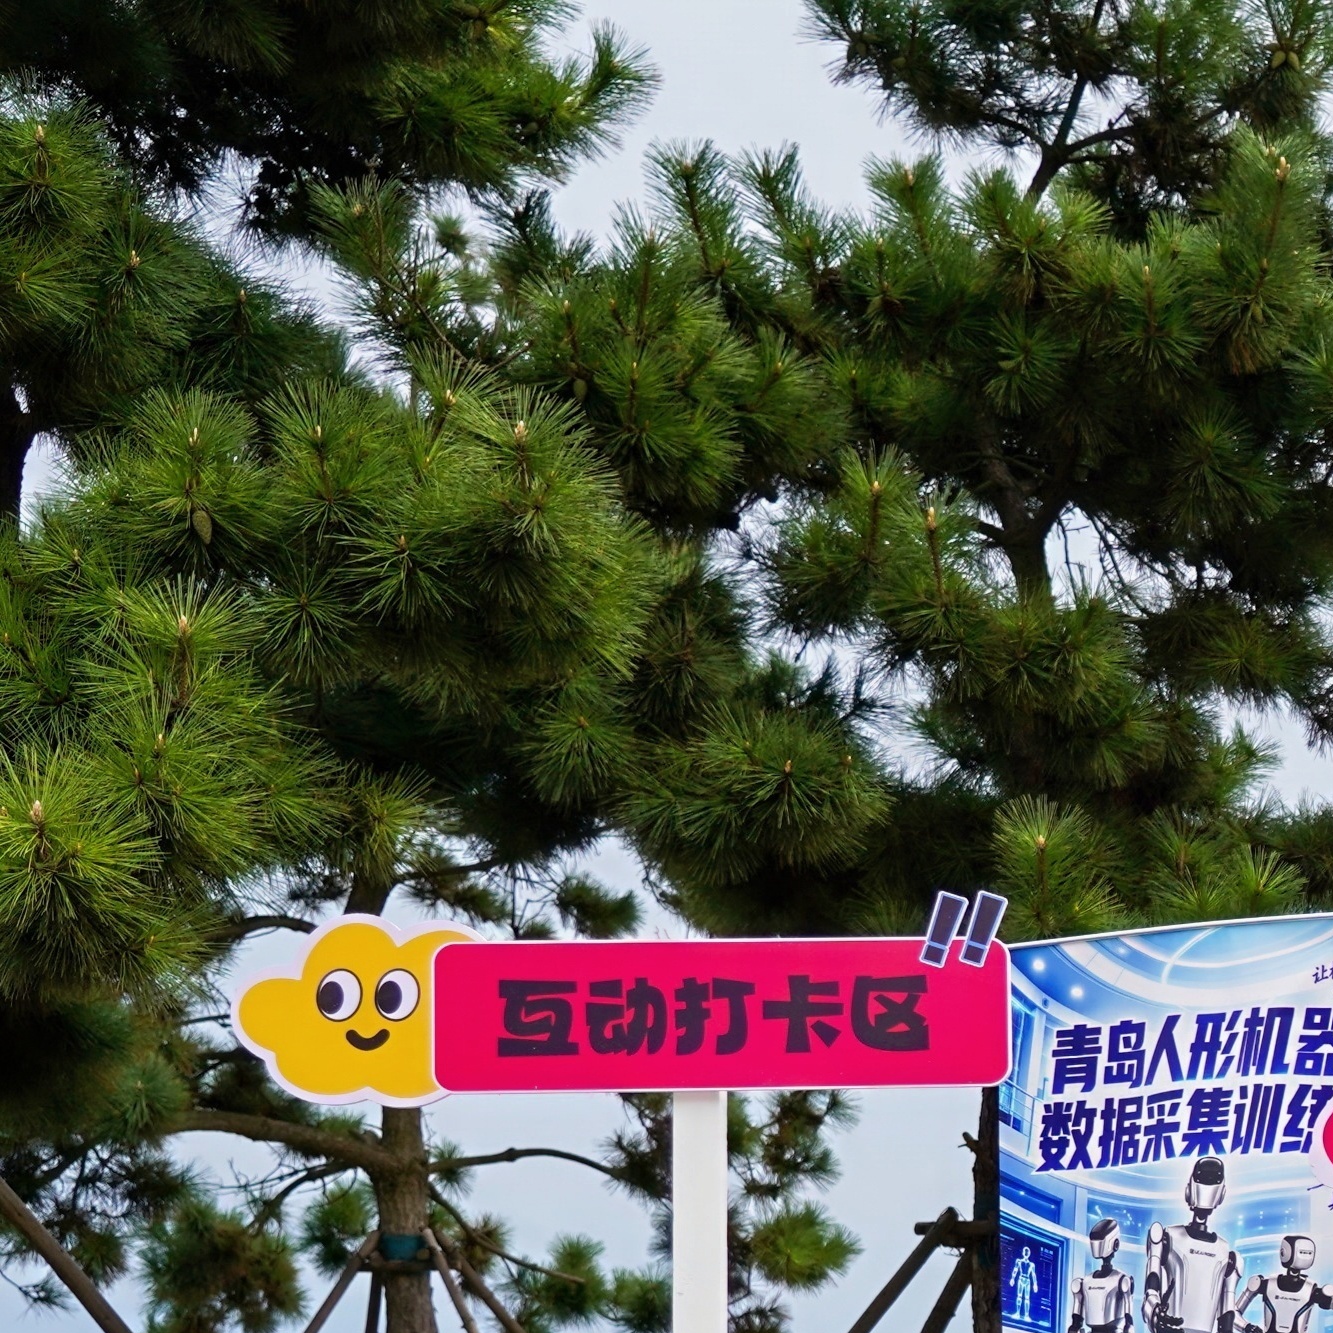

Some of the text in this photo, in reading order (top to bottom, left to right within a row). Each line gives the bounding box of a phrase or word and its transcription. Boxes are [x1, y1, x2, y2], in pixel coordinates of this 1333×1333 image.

[497, 975, 931, 1057] 互动打卡区
